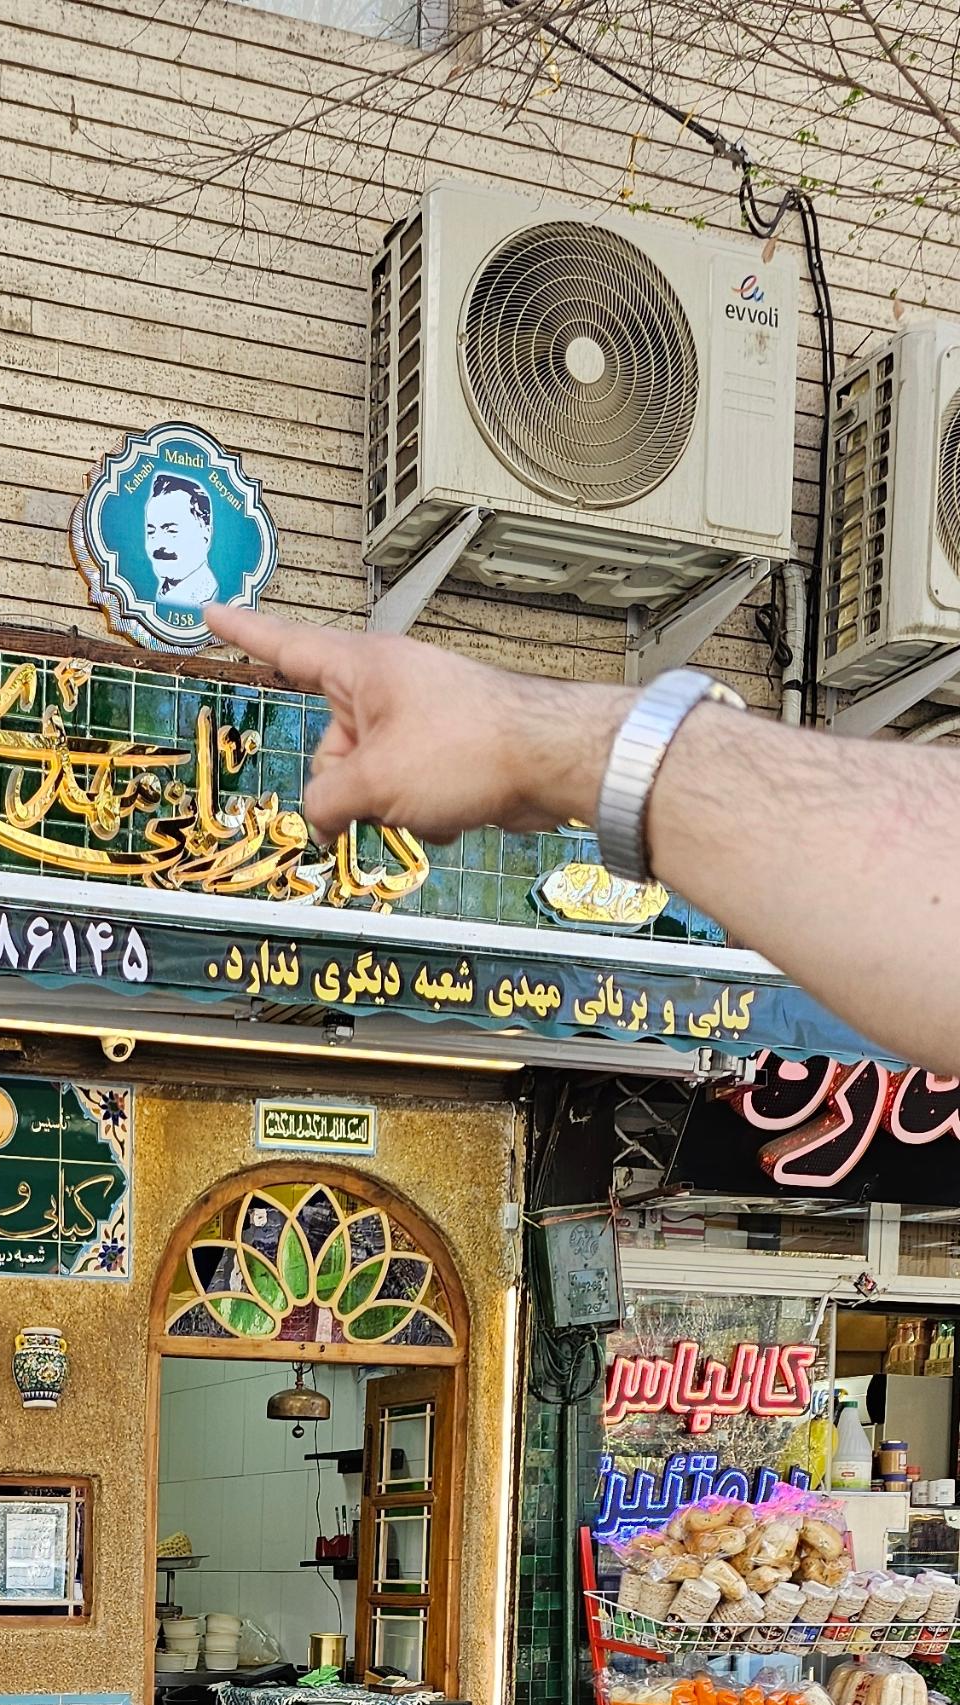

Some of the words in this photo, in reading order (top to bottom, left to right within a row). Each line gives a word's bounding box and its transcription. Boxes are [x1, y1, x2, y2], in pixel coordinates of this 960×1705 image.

[725, 303, 778, 329] evvoli
[124, 458, 156, 495] Kababi
[165, 448, 205, 469] Mahdi
[207, 470, 244, 512] Beryani
[167, 610, 195, 627] 1358
[314, 951, 401, 1005] دیگری
[414, 960, 474, 1011] شعبه
[488, 974, 562, 1018] مهدی
[573, 973, 648, 1032] بریانی
[662, 999, 676, 1035] و
[688, 986, 755, 1040] کبابی
[14, 1245, 46, 1269] شعبه
[603, 1340, 818, 1434] کالباس
